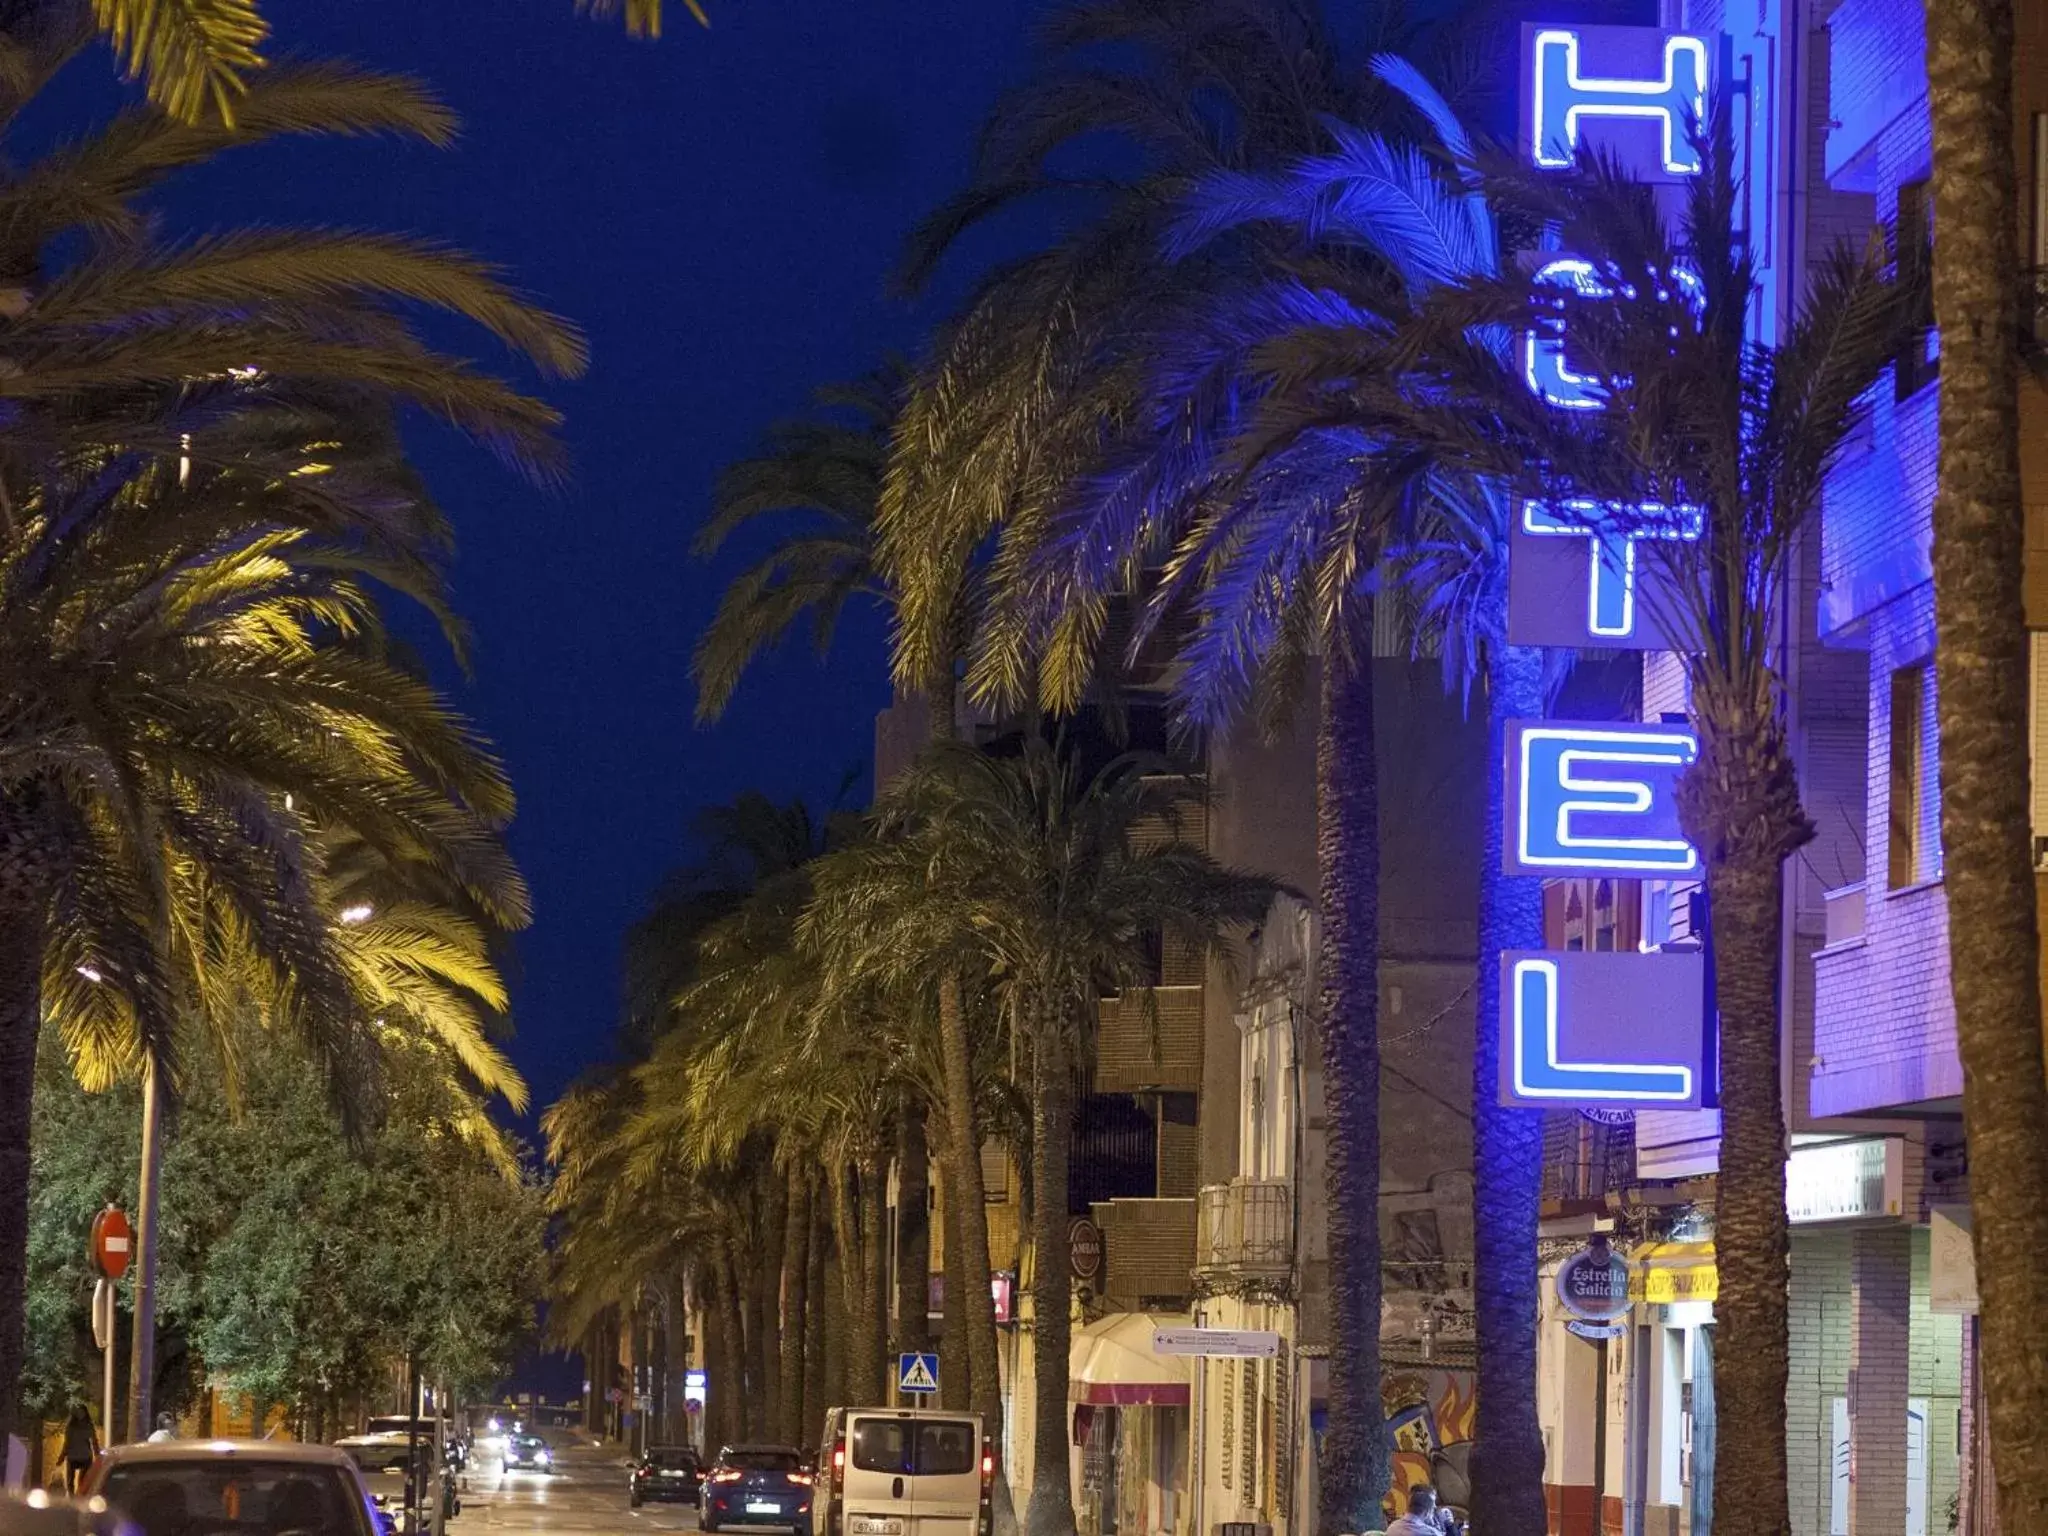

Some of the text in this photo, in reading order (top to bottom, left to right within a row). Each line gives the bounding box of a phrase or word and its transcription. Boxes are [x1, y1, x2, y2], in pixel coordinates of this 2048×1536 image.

[1513, 30, 1707, 1100] HOTEL
[1572, 1266, 1626, 1282] Estrella
[1574, 1281, 1624, 1298] Galicia
